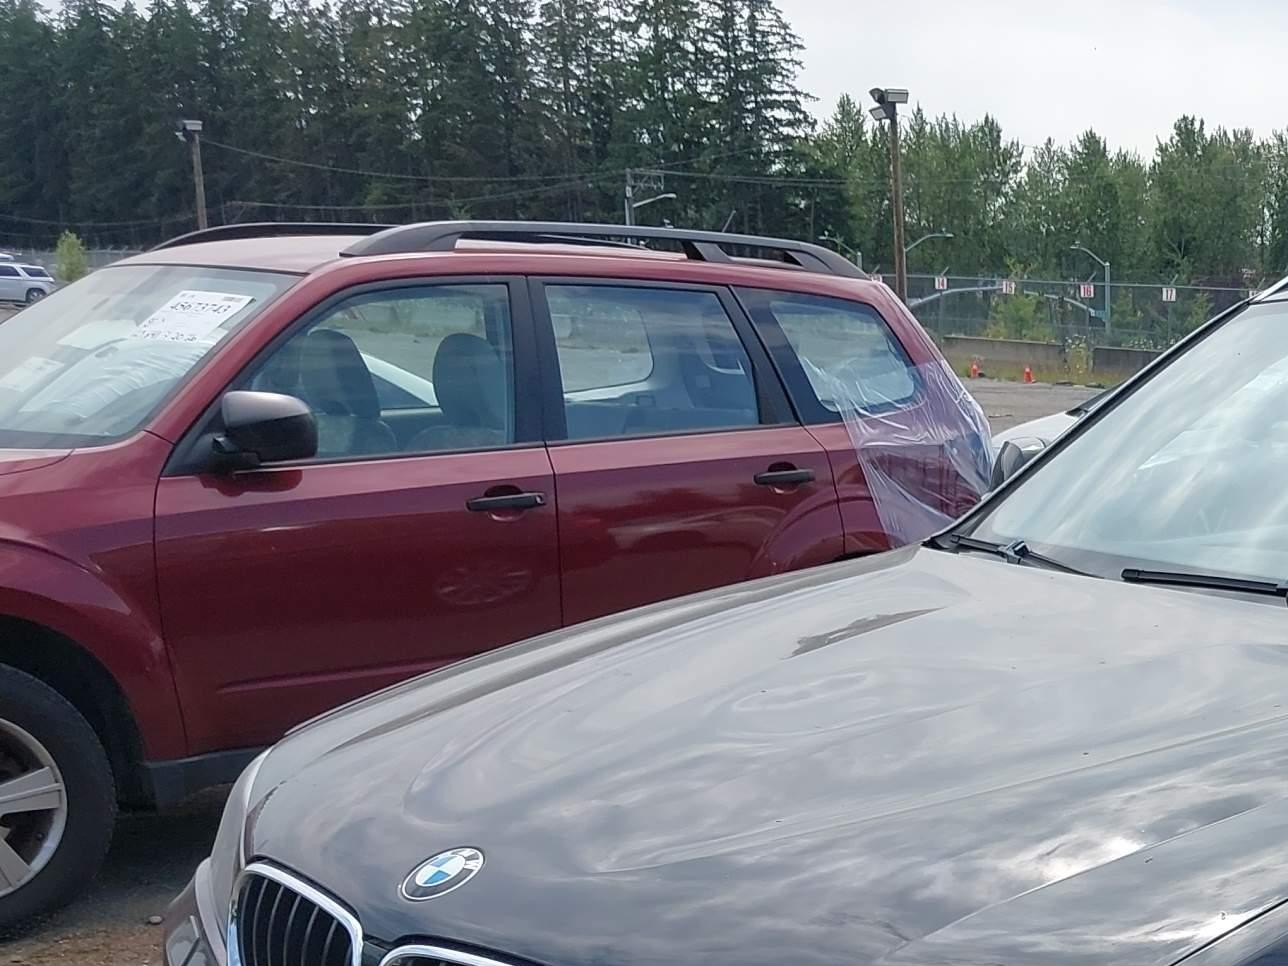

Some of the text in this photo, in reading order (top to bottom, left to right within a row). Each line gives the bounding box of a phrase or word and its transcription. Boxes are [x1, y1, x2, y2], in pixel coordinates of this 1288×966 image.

[937, 277, 945, 289] 14
[1005, 281, 1013, 293] 15
[1083, 285, 1092, 297] 16
[1166, 288, 1173, 300] 17
